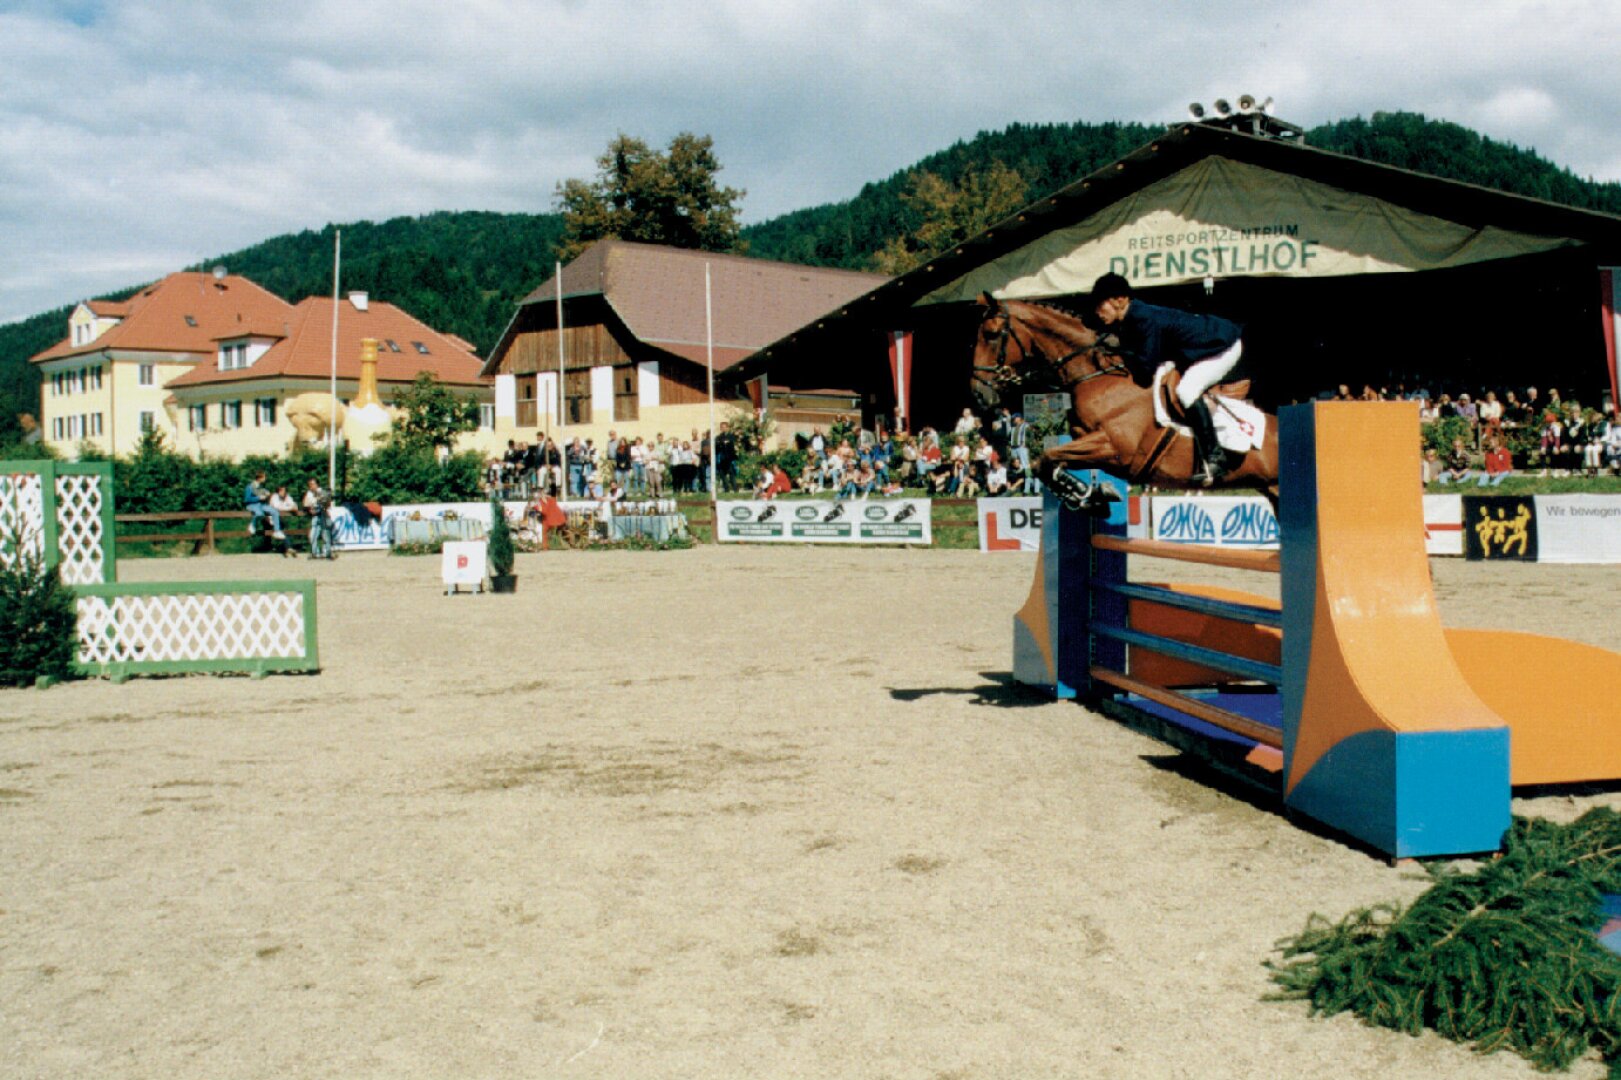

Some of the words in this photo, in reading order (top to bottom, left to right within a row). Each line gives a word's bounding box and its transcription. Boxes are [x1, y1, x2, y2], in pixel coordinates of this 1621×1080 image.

[1128, 224, 1299, 250] REITSPORTZENTRUM
[1109, 240, 1320, 280] DIENSTLHOF
[1158, 502, 1216, 543] OMYA
[1221, 502, 1280, 543] OMYA
[1546, 506, 1565, 517] Wir
